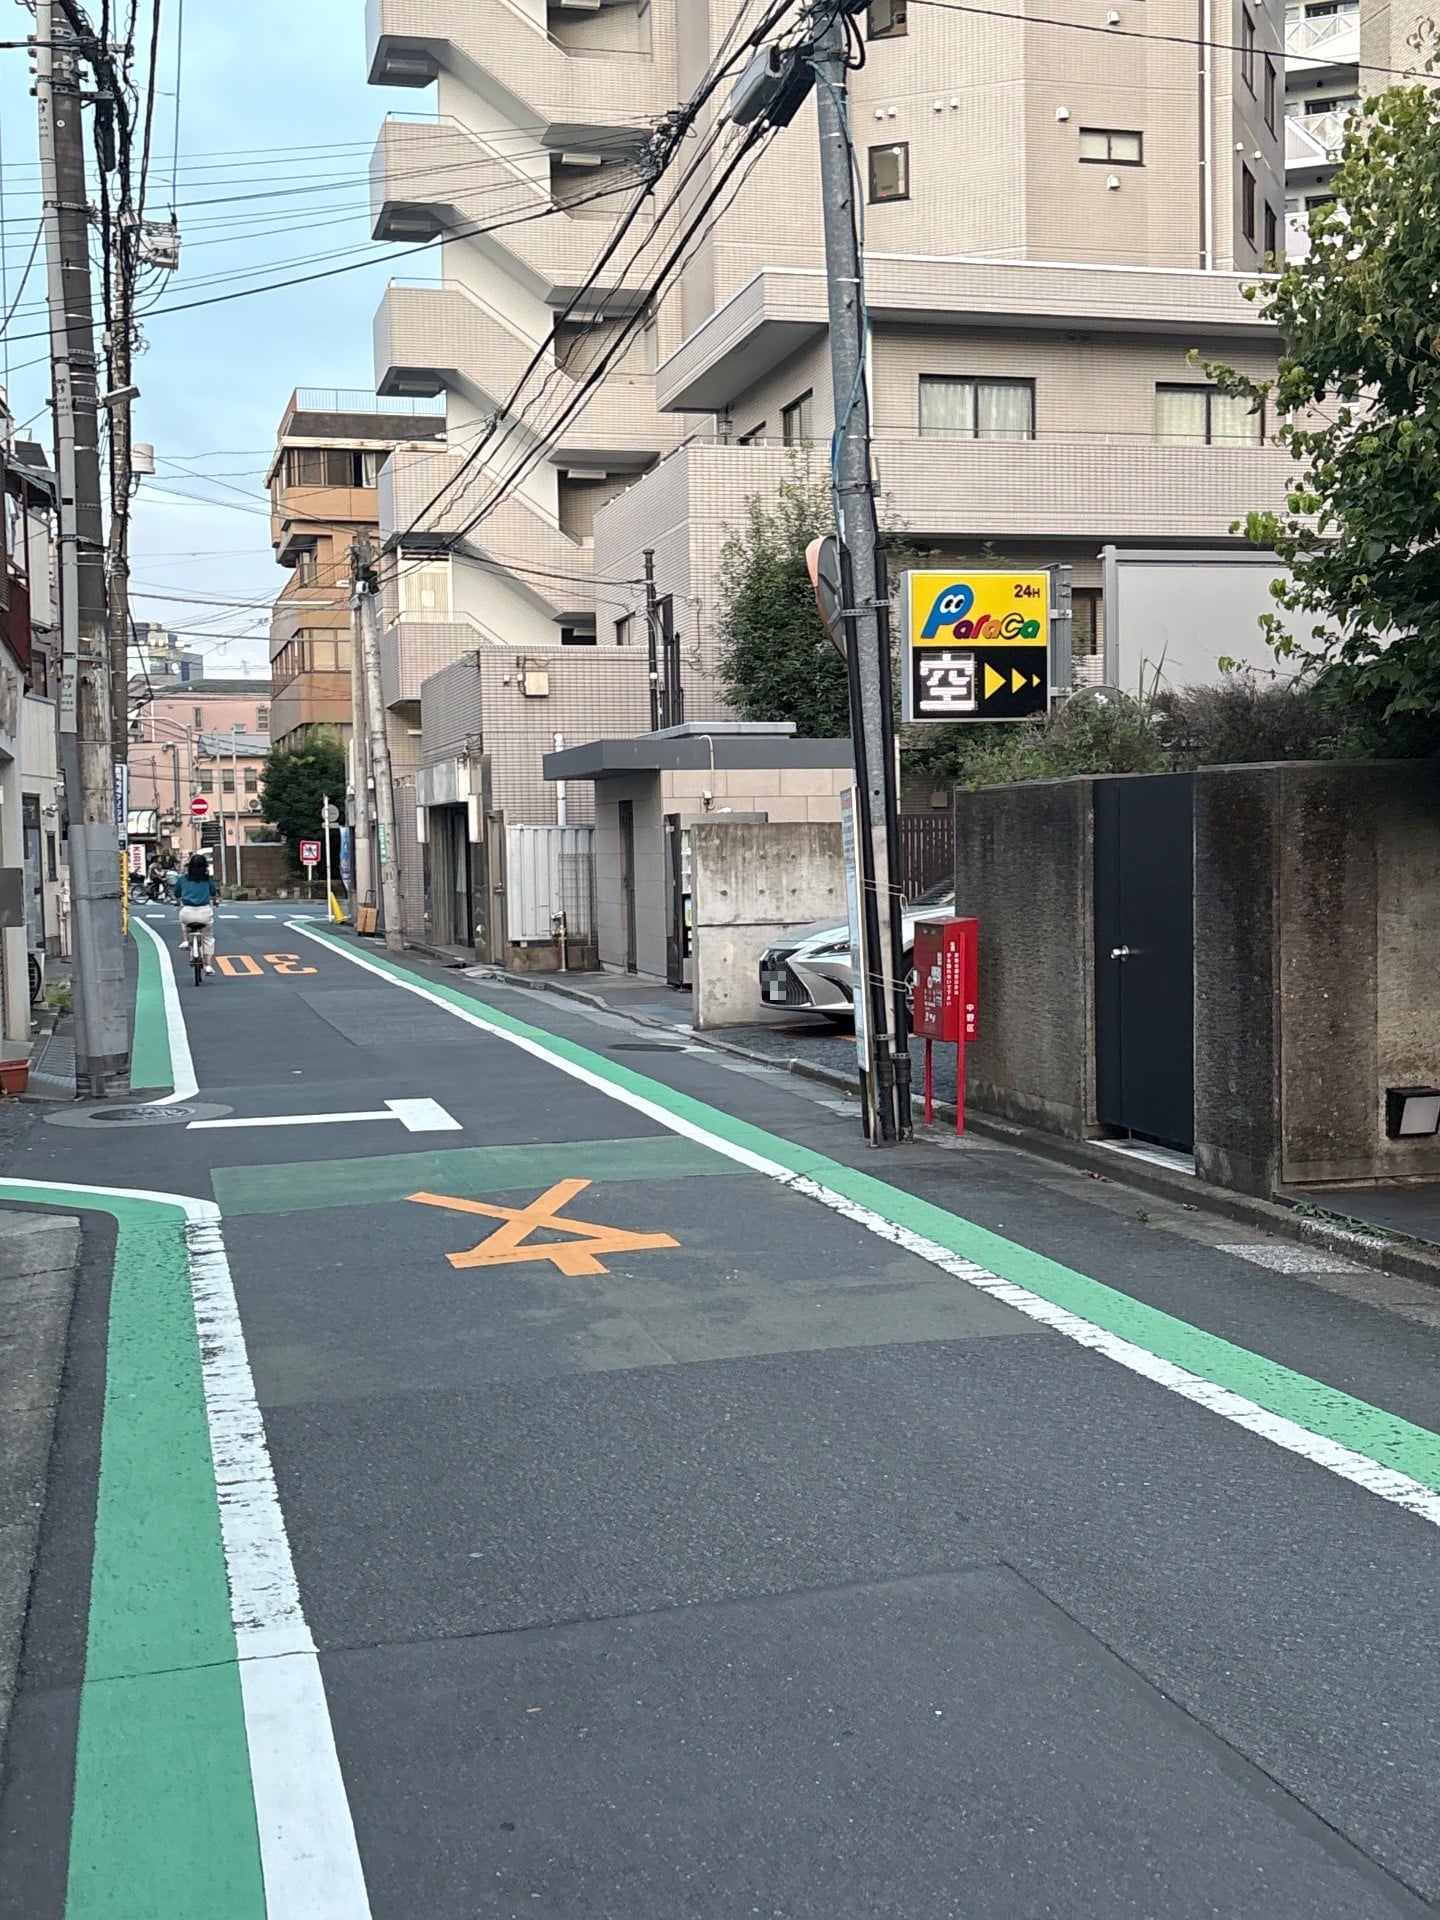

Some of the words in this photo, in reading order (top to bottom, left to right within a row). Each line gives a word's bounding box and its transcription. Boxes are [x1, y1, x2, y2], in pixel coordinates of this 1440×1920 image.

[1014, 584, 1040, 599] 24H
[919, 652, 976, 712] 空
[133, 846, 142, 873] KIRIN
[215, 953, 318, 976] 30
